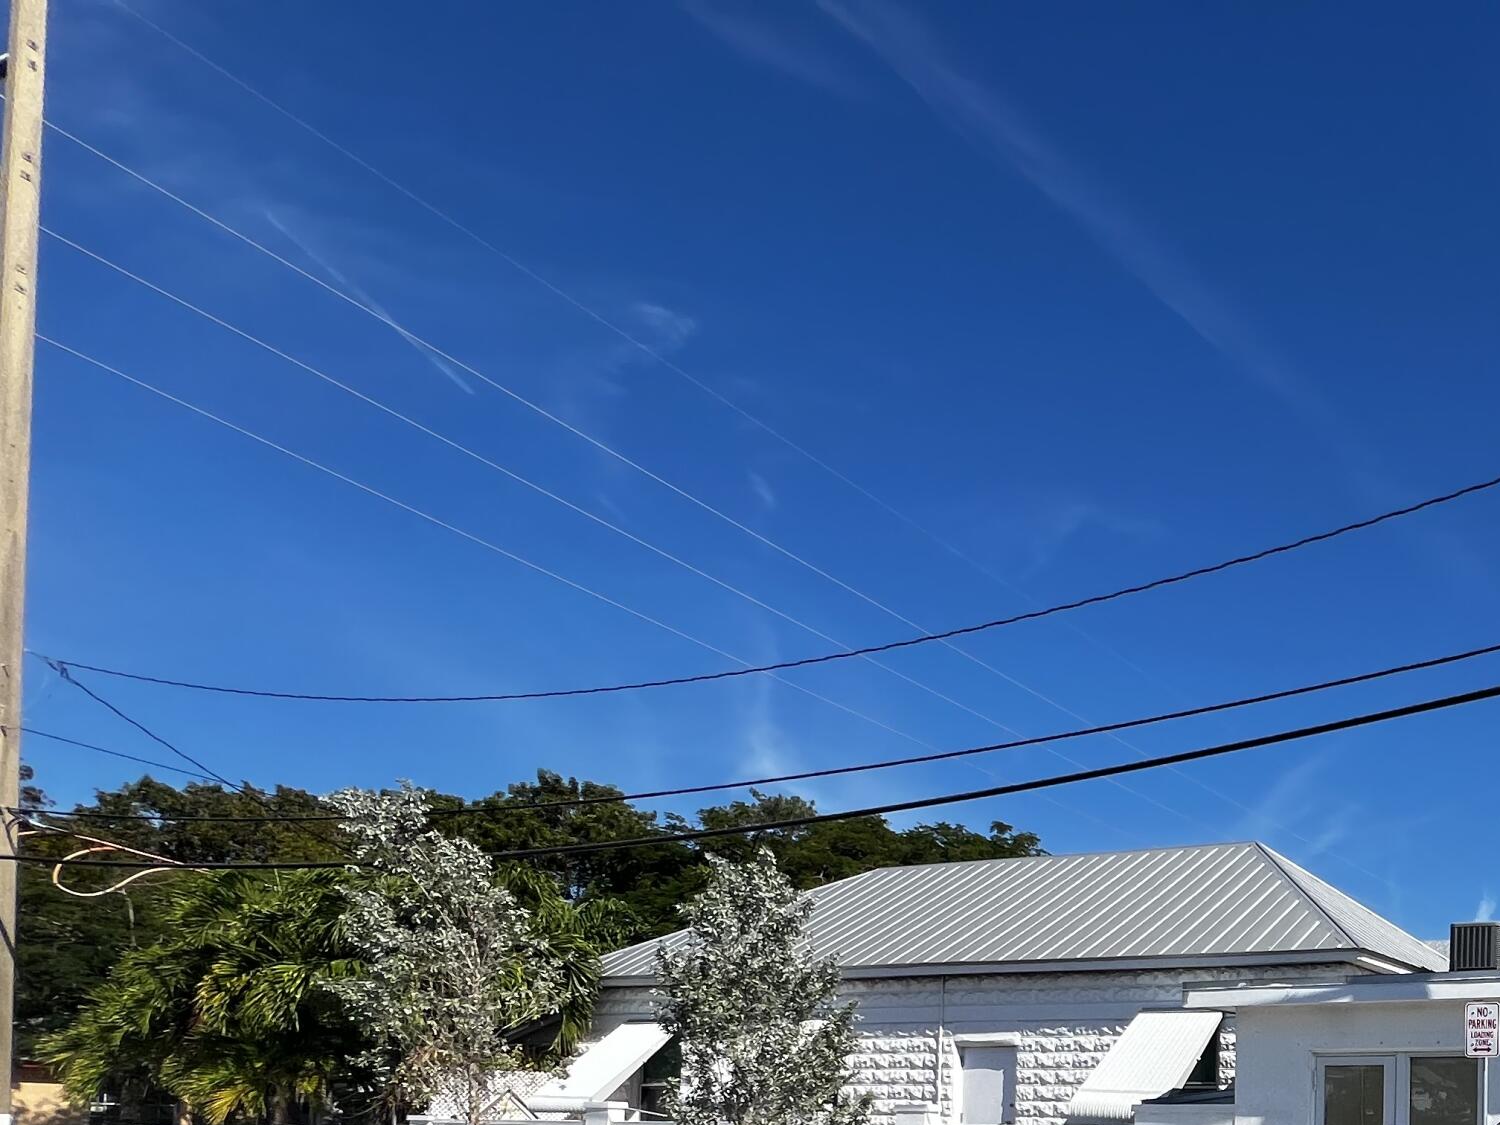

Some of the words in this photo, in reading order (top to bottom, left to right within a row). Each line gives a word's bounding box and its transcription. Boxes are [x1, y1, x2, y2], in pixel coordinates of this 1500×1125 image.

[1476, 1007, 1488, 1018] NO
[1468, 1019, 1497, 1030] PARKING
[1470, 1031, 1494, 1039] LOADING
[1475, 1039, 1490, 1047] ZONE
